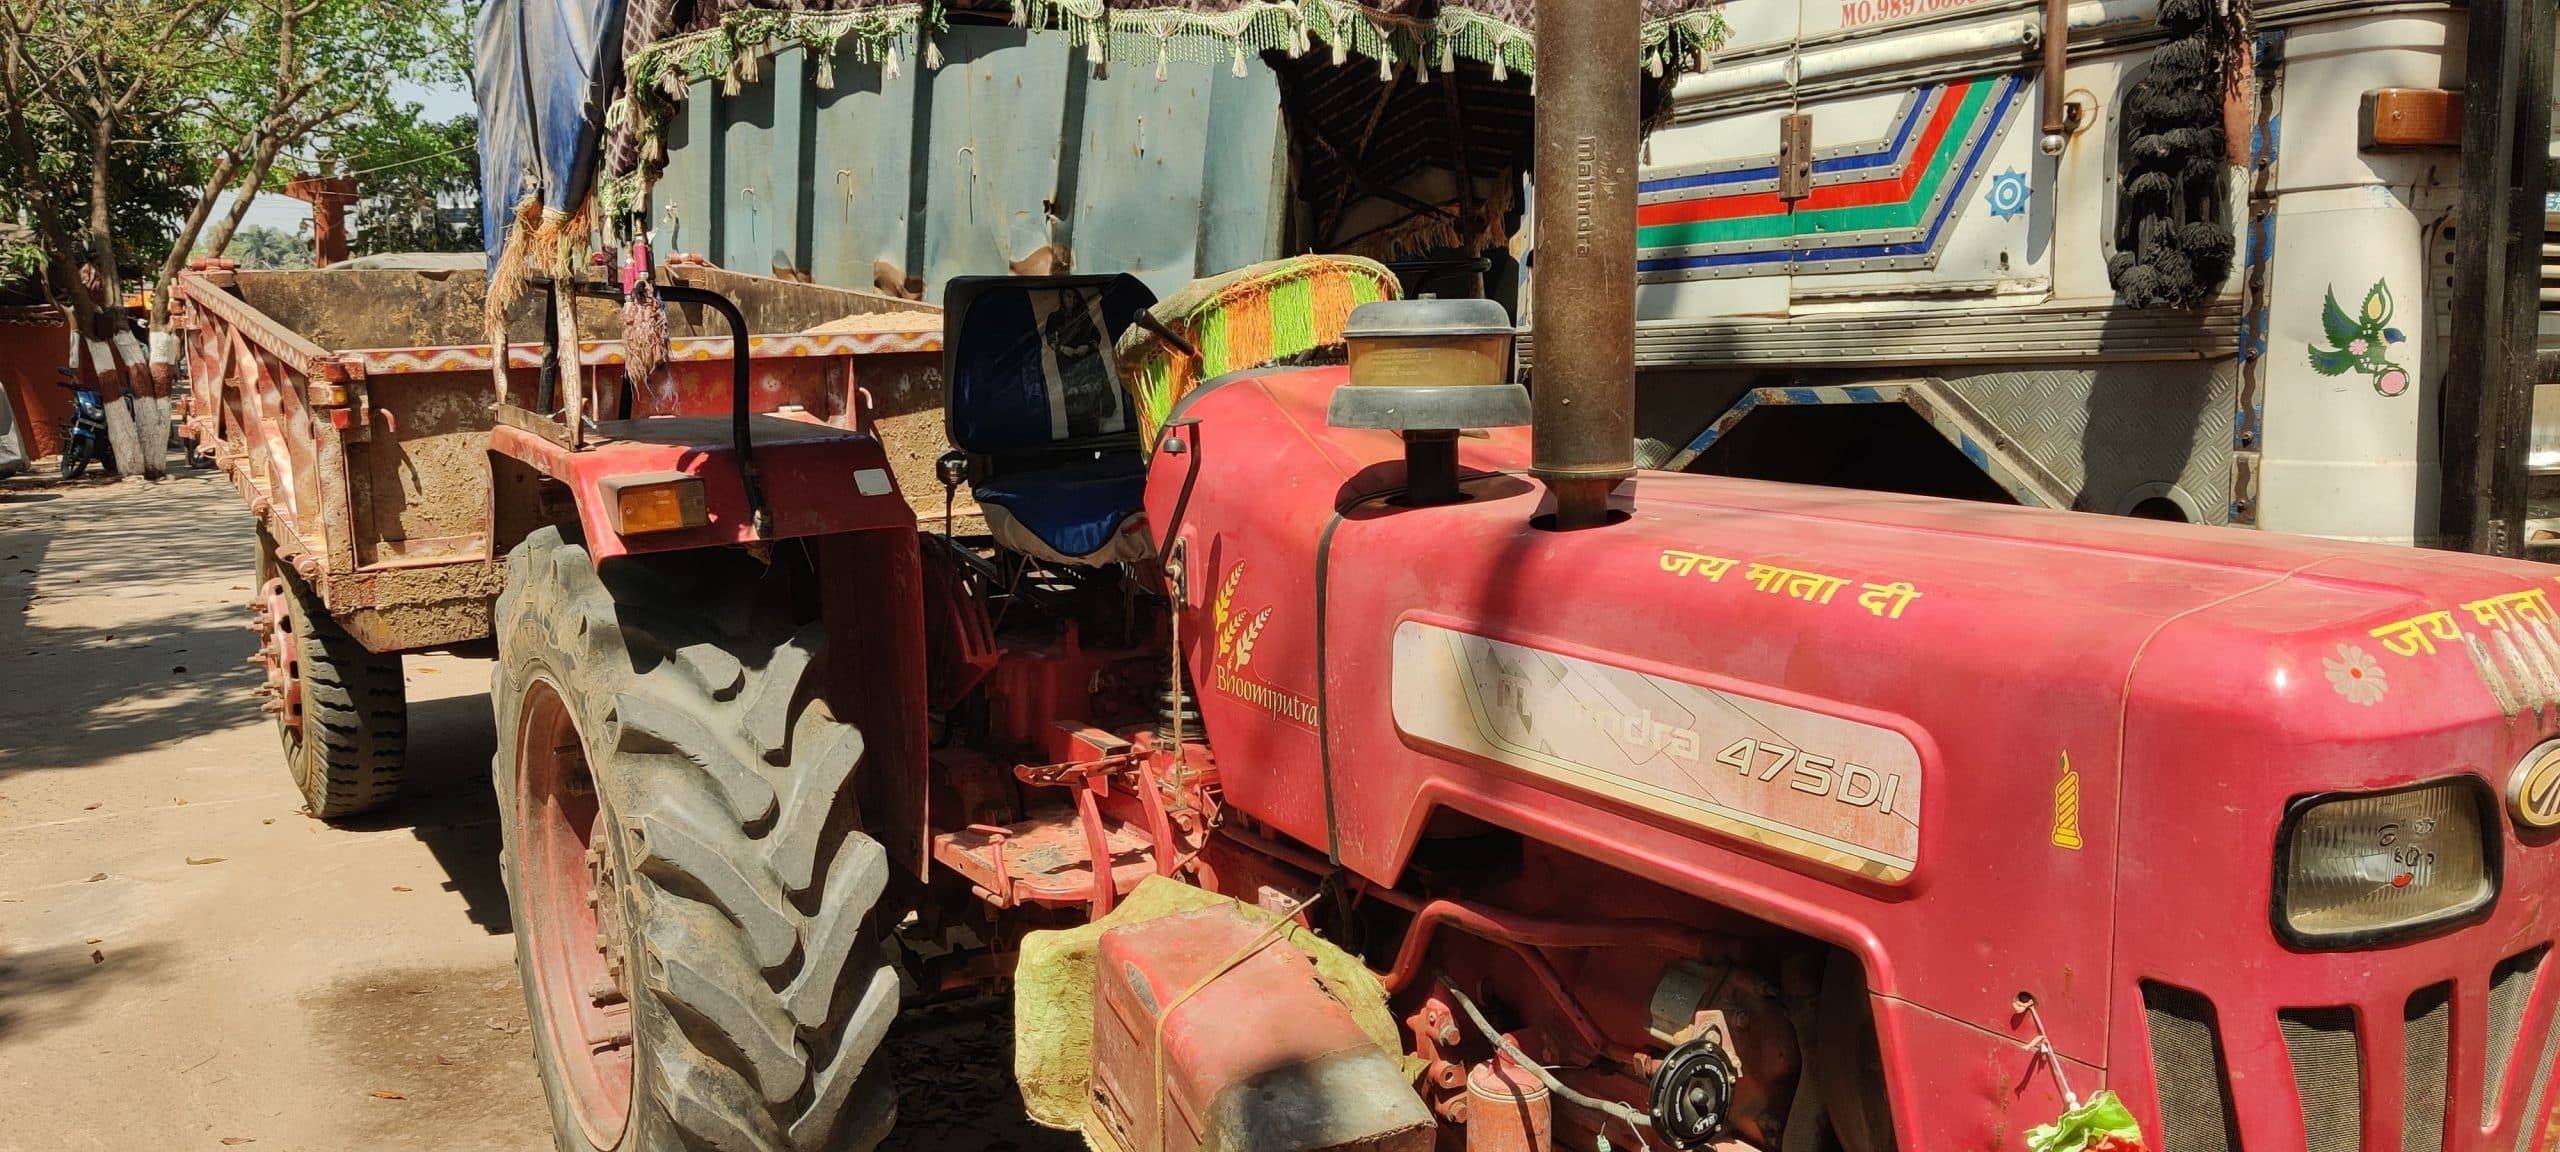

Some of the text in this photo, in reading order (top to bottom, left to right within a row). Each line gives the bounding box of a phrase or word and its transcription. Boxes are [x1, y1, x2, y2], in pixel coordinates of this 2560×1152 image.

[1659, 549, 1924, 619] जय माता दी
[2368, 610, 2465, 656] जय
[1216, 664, 1319, 726] Bhoomiputra
